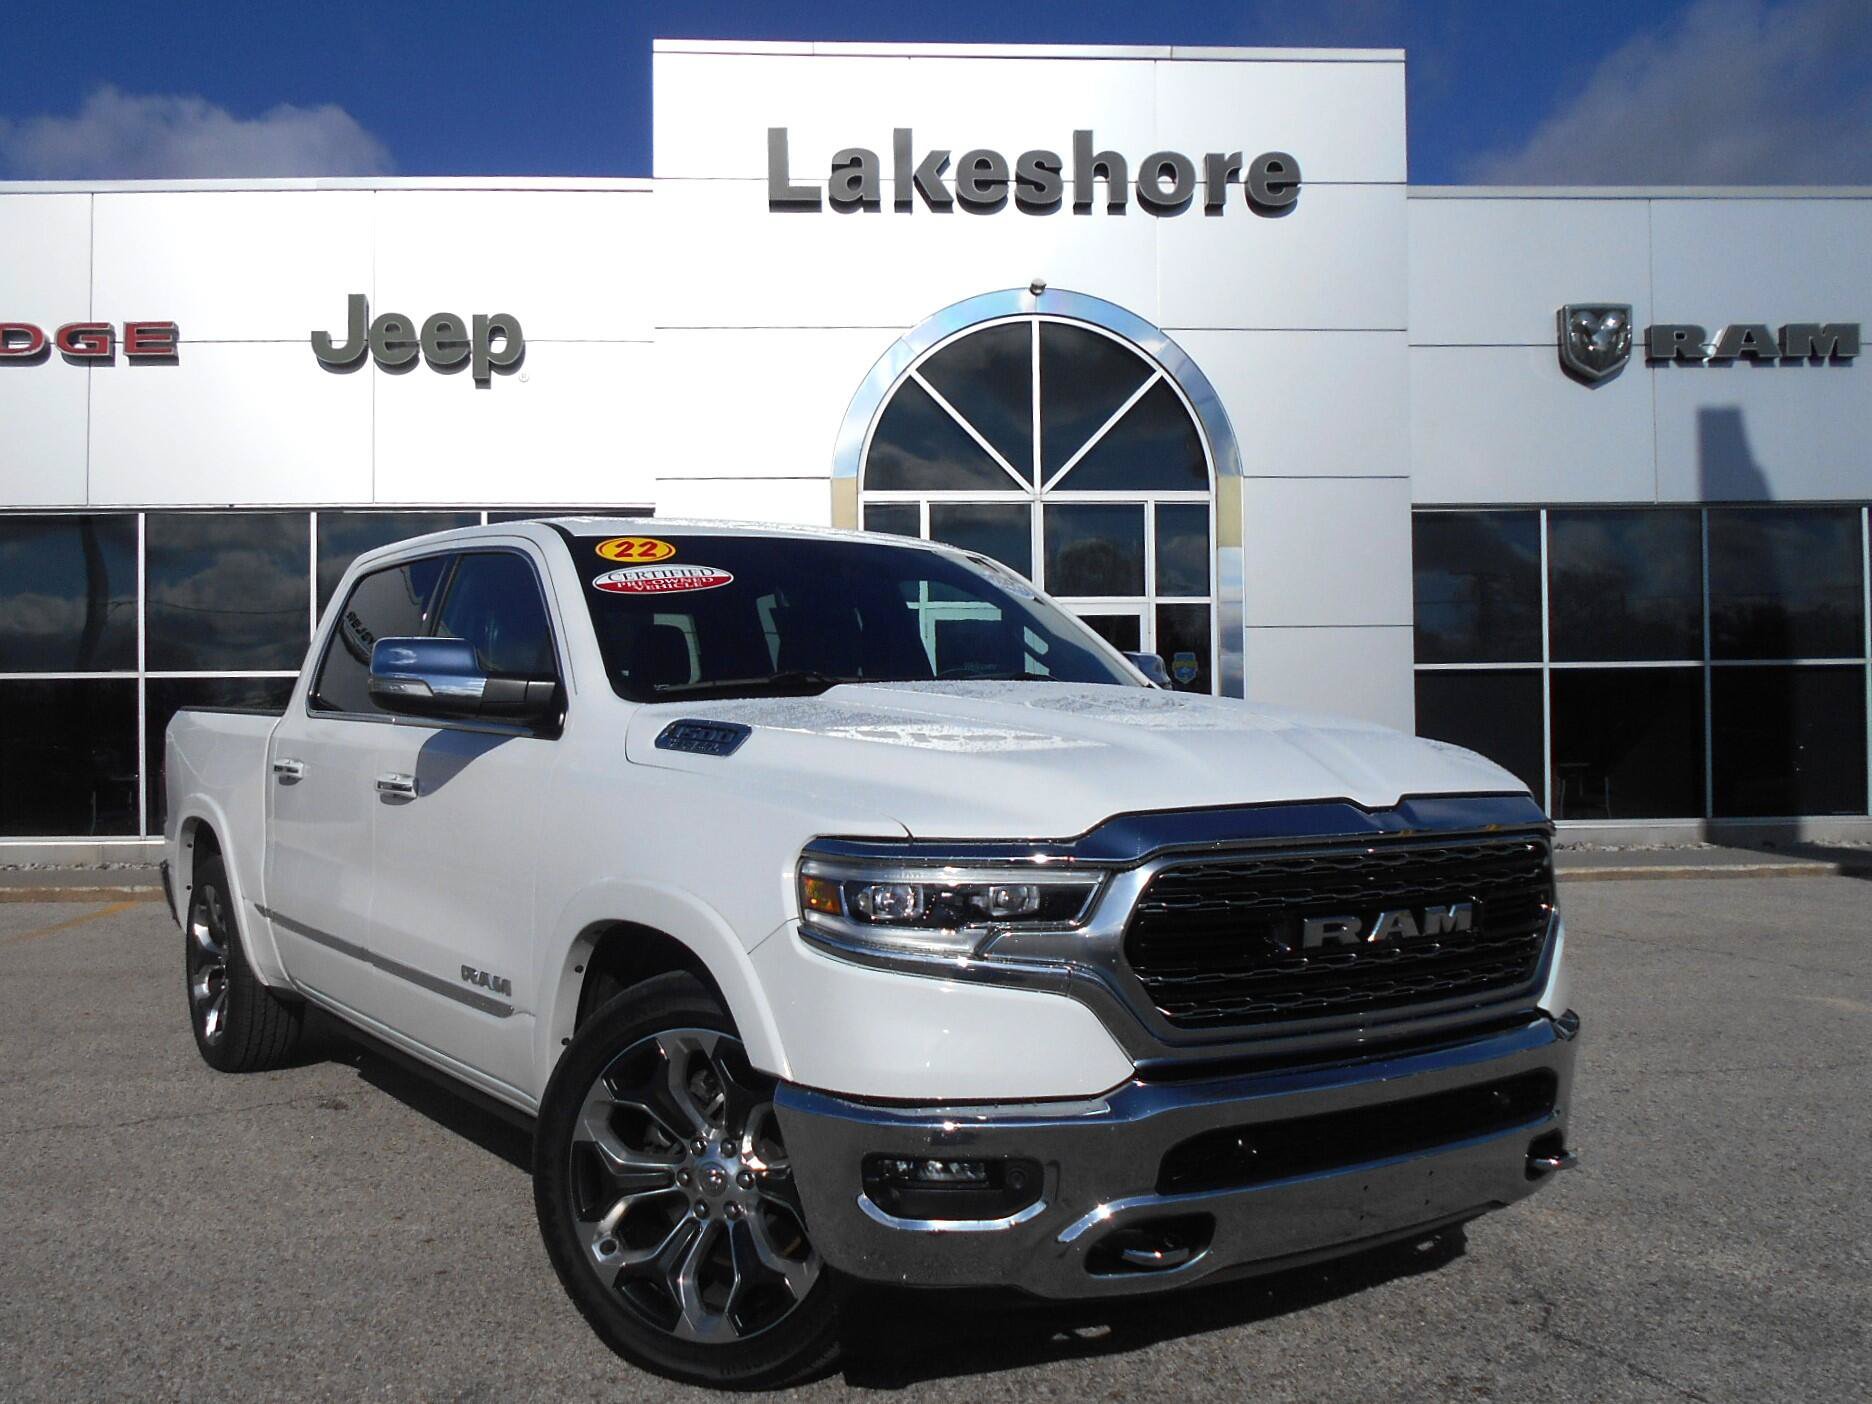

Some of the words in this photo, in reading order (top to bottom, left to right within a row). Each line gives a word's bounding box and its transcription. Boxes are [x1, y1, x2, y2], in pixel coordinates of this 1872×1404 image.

[767, 127, 1302, 216] Lakeshore
[311, 293, 525, 389] Jeep
[1644, 322, 1861, 367] RAM
[613, 540, 659, 559] 22
[607, 567, 715, 582] CERTIFIED
[617, 577, 714, 589] PRE-OWNED
[633, 581, 704, 592] VEHICLE
[1302, 902, 1473, 949] RAM
[460, 964, 512, 997] RAM
